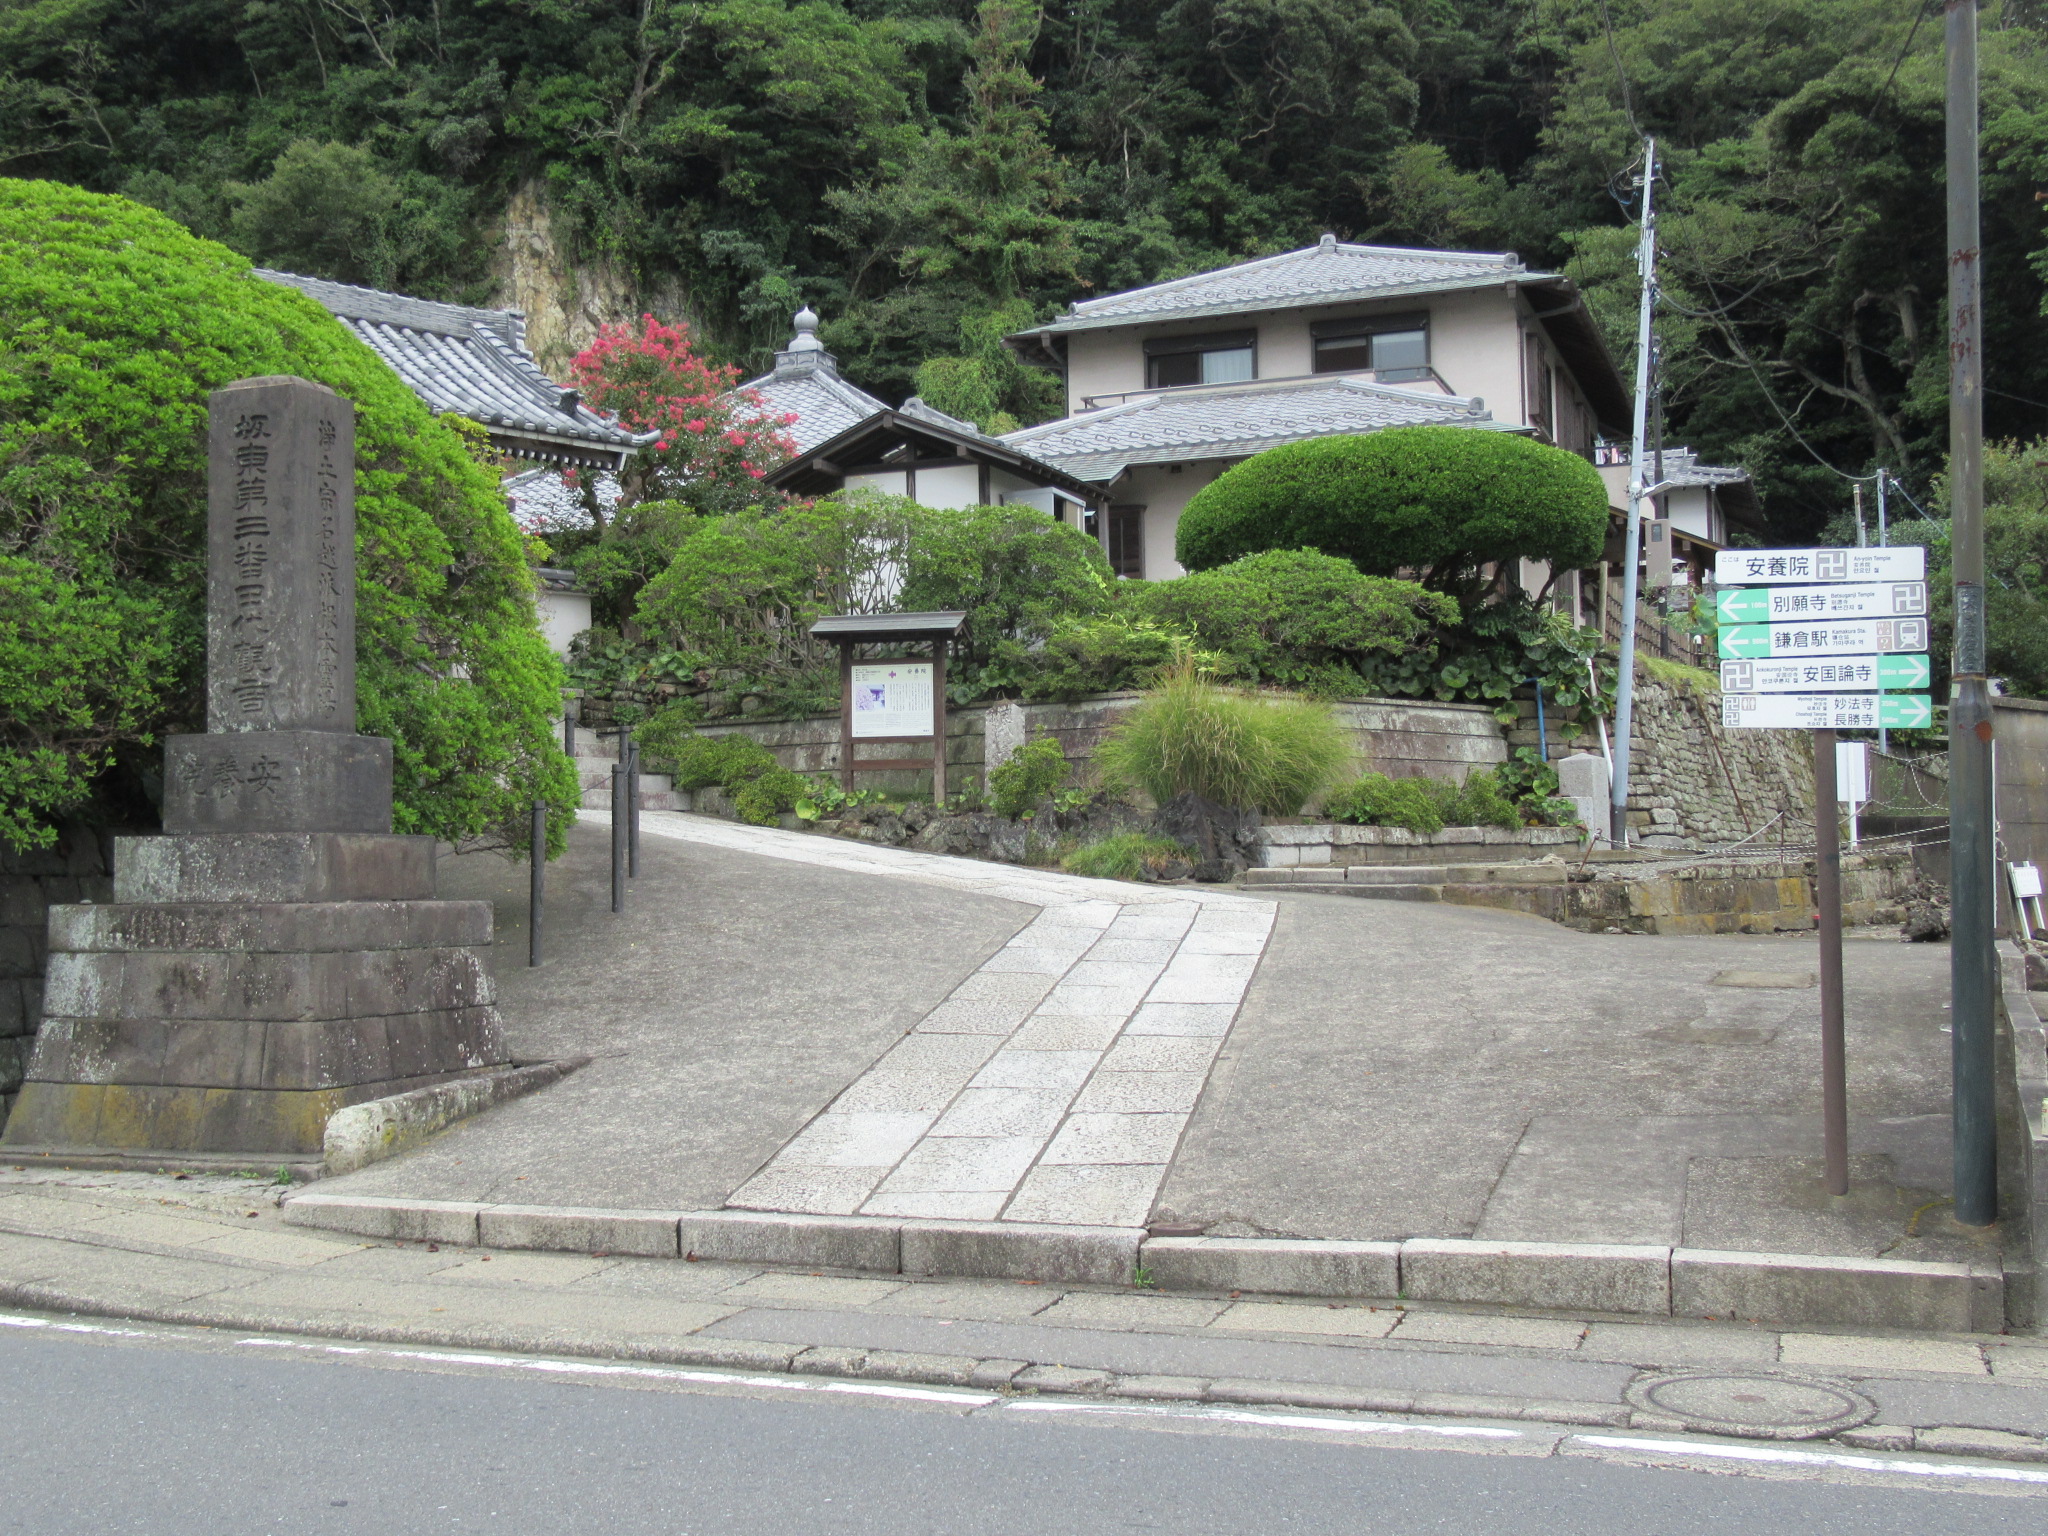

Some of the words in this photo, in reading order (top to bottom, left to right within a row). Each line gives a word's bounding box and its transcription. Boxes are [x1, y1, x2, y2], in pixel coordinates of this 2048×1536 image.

[1746, 556, 1809, 576] 安養院
[1773, 594, 1826, 613] 別願寺
[1774, 630, 1828, 648] 鎌倉駅
[1803, 664, 1872, 683] 安国論寺
[1834, 697, 1874, 710] 妙法寺
[1834, 713, 1874, 726] 長勝寺
